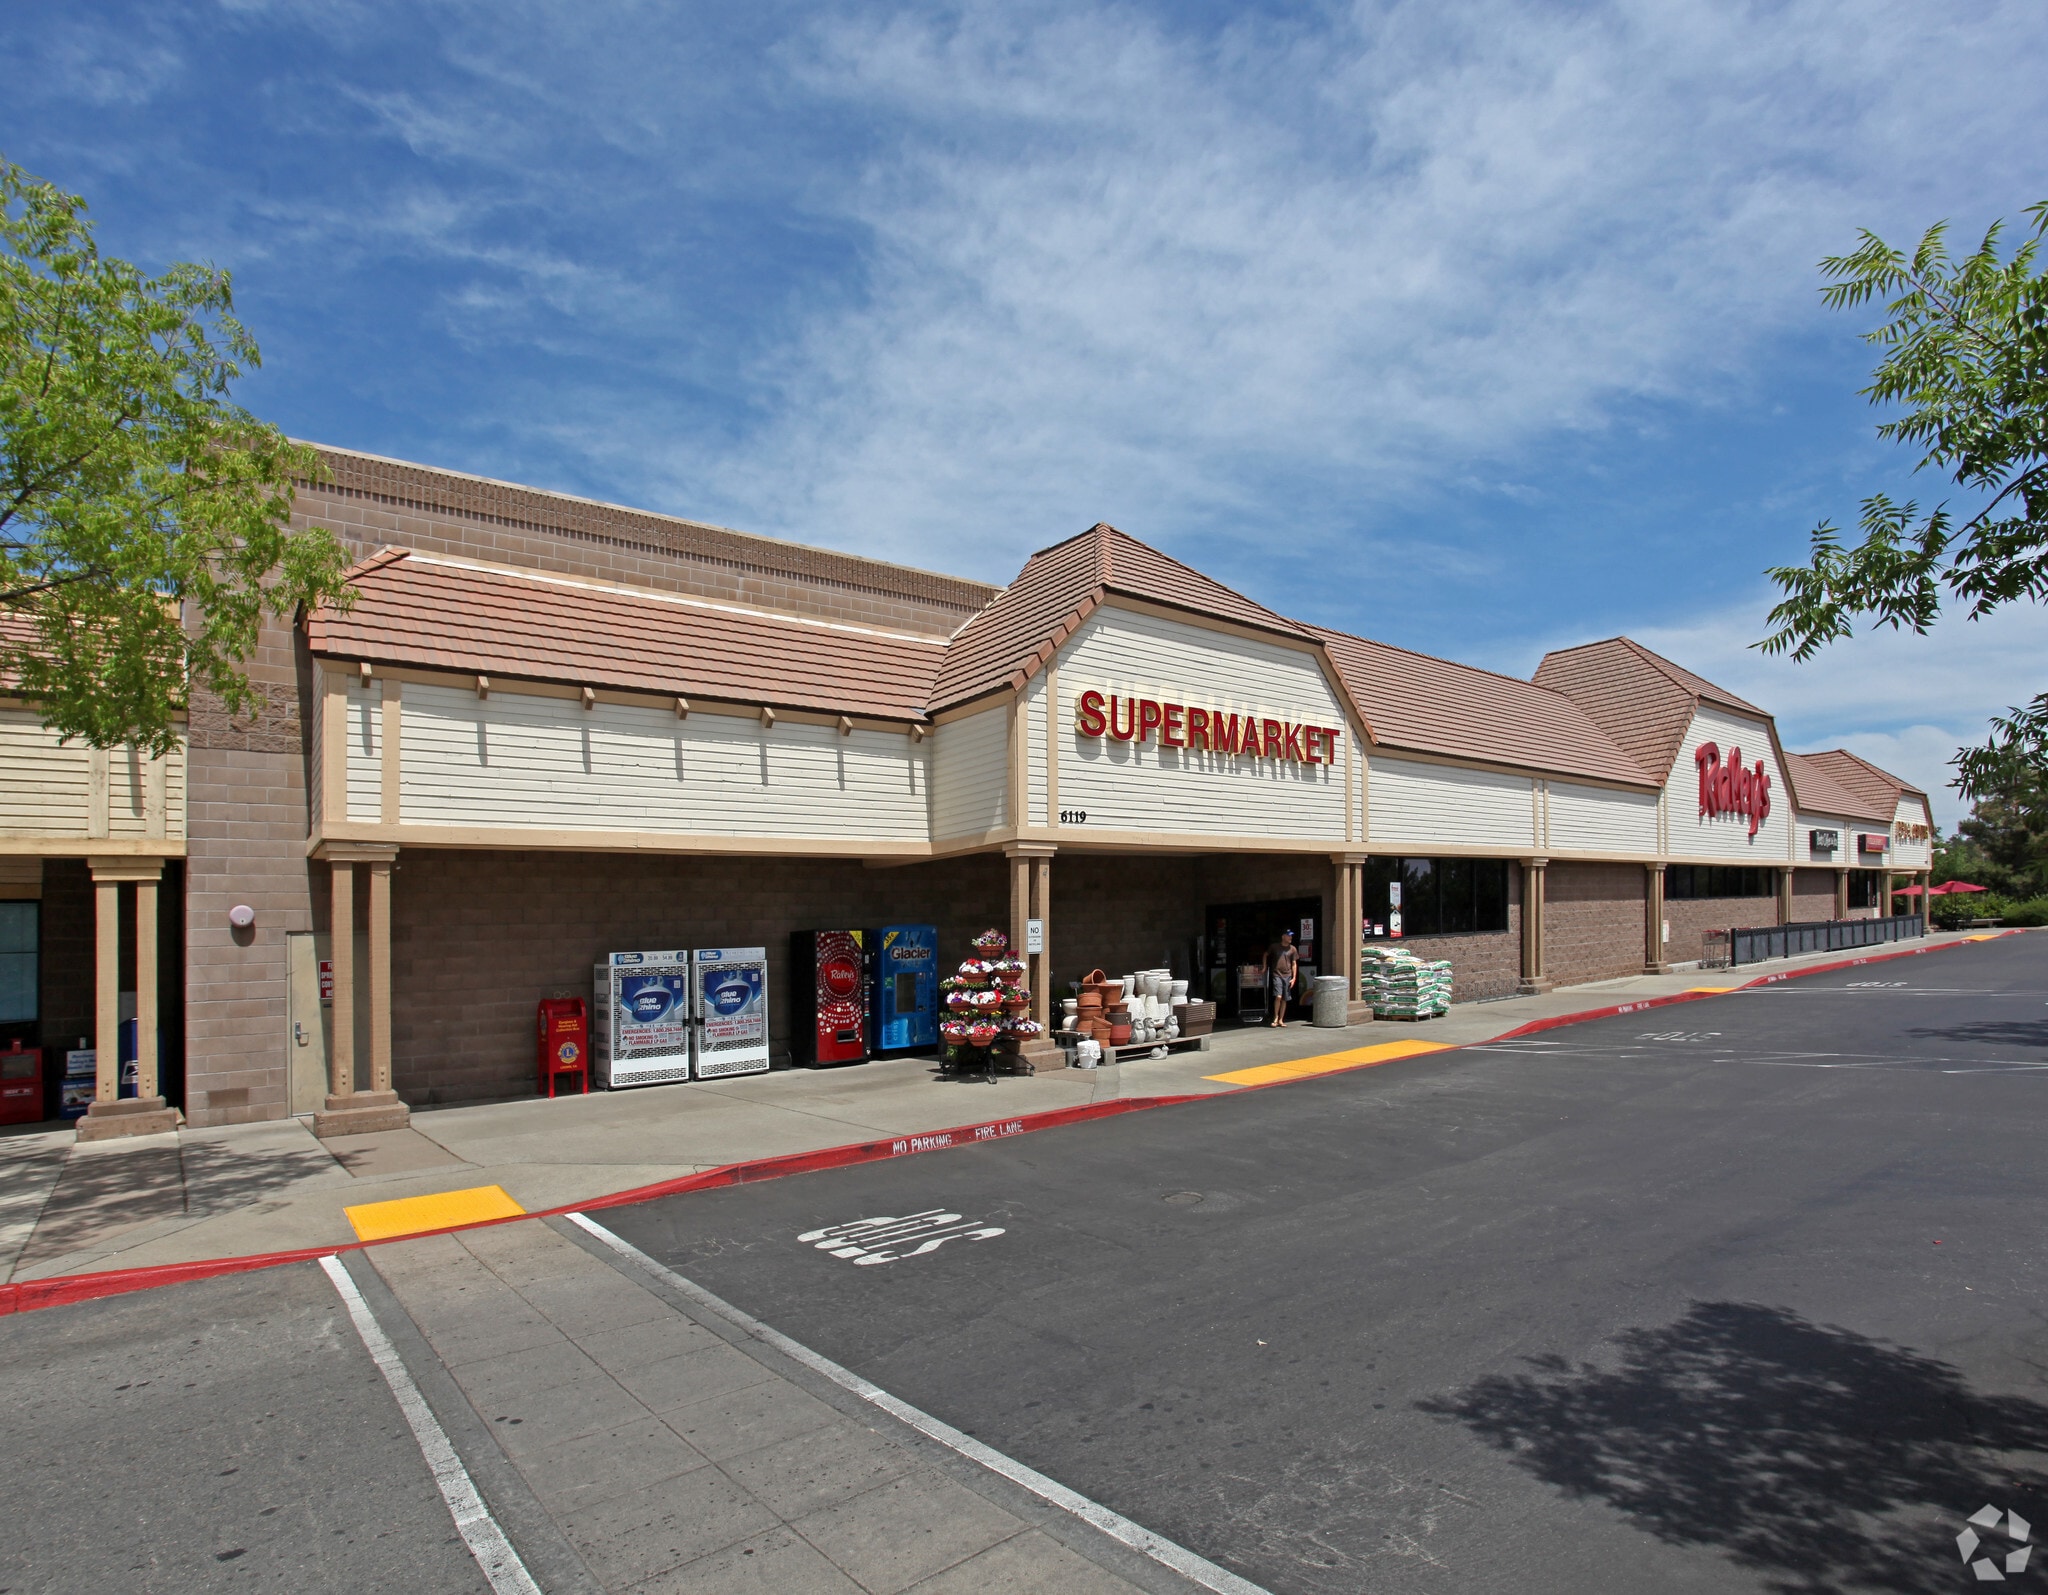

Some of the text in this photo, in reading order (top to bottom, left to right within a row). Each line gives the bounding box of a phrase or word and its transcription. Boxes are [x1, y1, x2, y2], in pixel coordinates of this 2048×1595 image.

[1076, 690, 1340, 766] SUPERMARKET
[1695, 741, 1771, 835] Raley's
[1060, 810, 1087, 824] 6119
[891, 947, 931, 960] Glacier
[831, 970, 855, 980] Raley's
[975, 1120, 1024, 1140] FIRE LANE
[892, 1134, 952, 1154] NO PARKING
